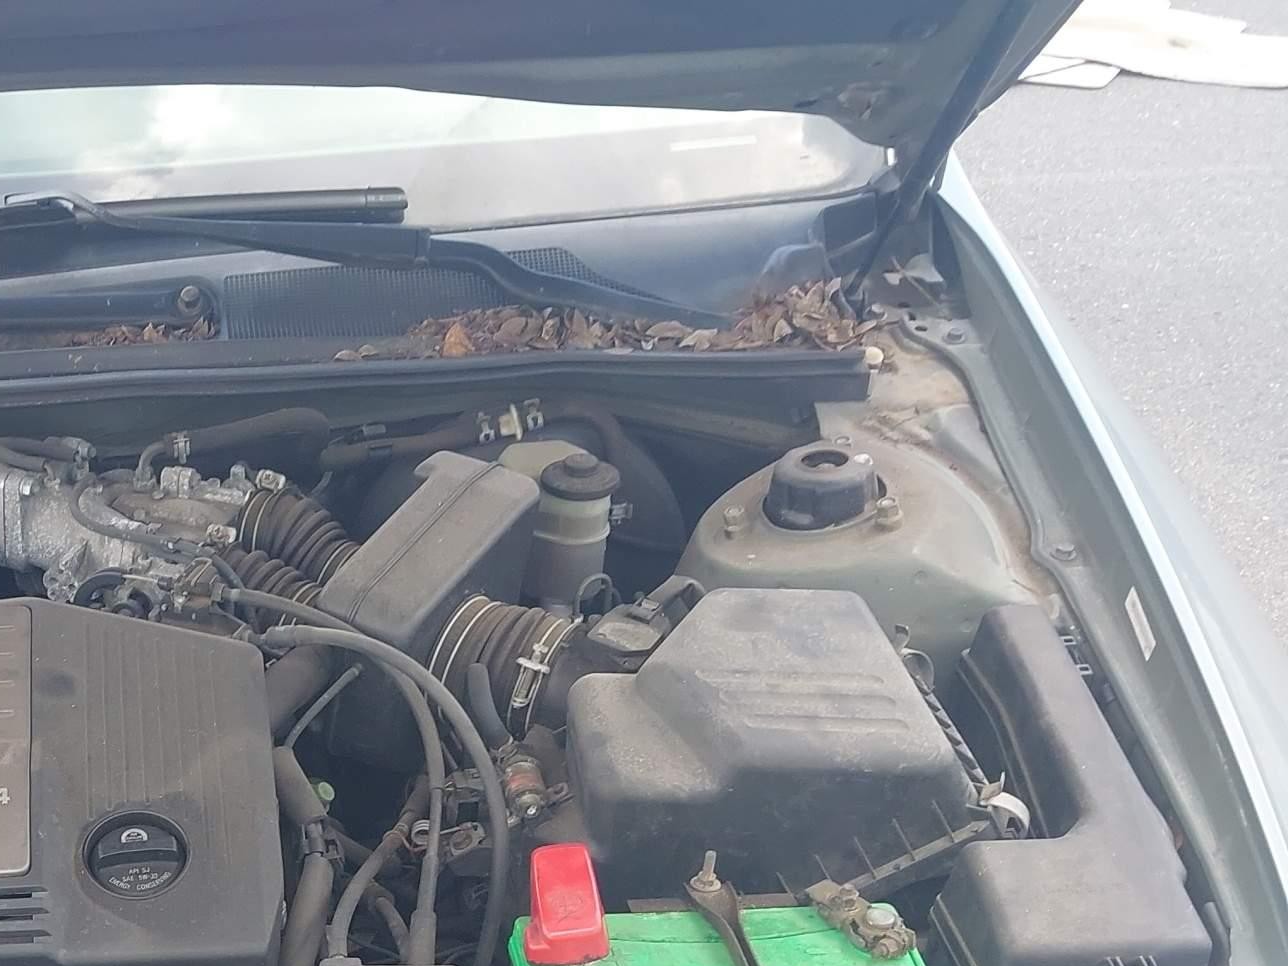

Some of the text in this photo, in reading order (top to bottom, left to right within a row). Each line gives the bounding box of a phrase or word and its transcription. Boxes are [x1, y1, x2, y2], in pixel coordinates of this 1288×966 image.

[109, 871, 172, 890] ENERGY CONSERVING
[122, 874, 134, 882] SAE
